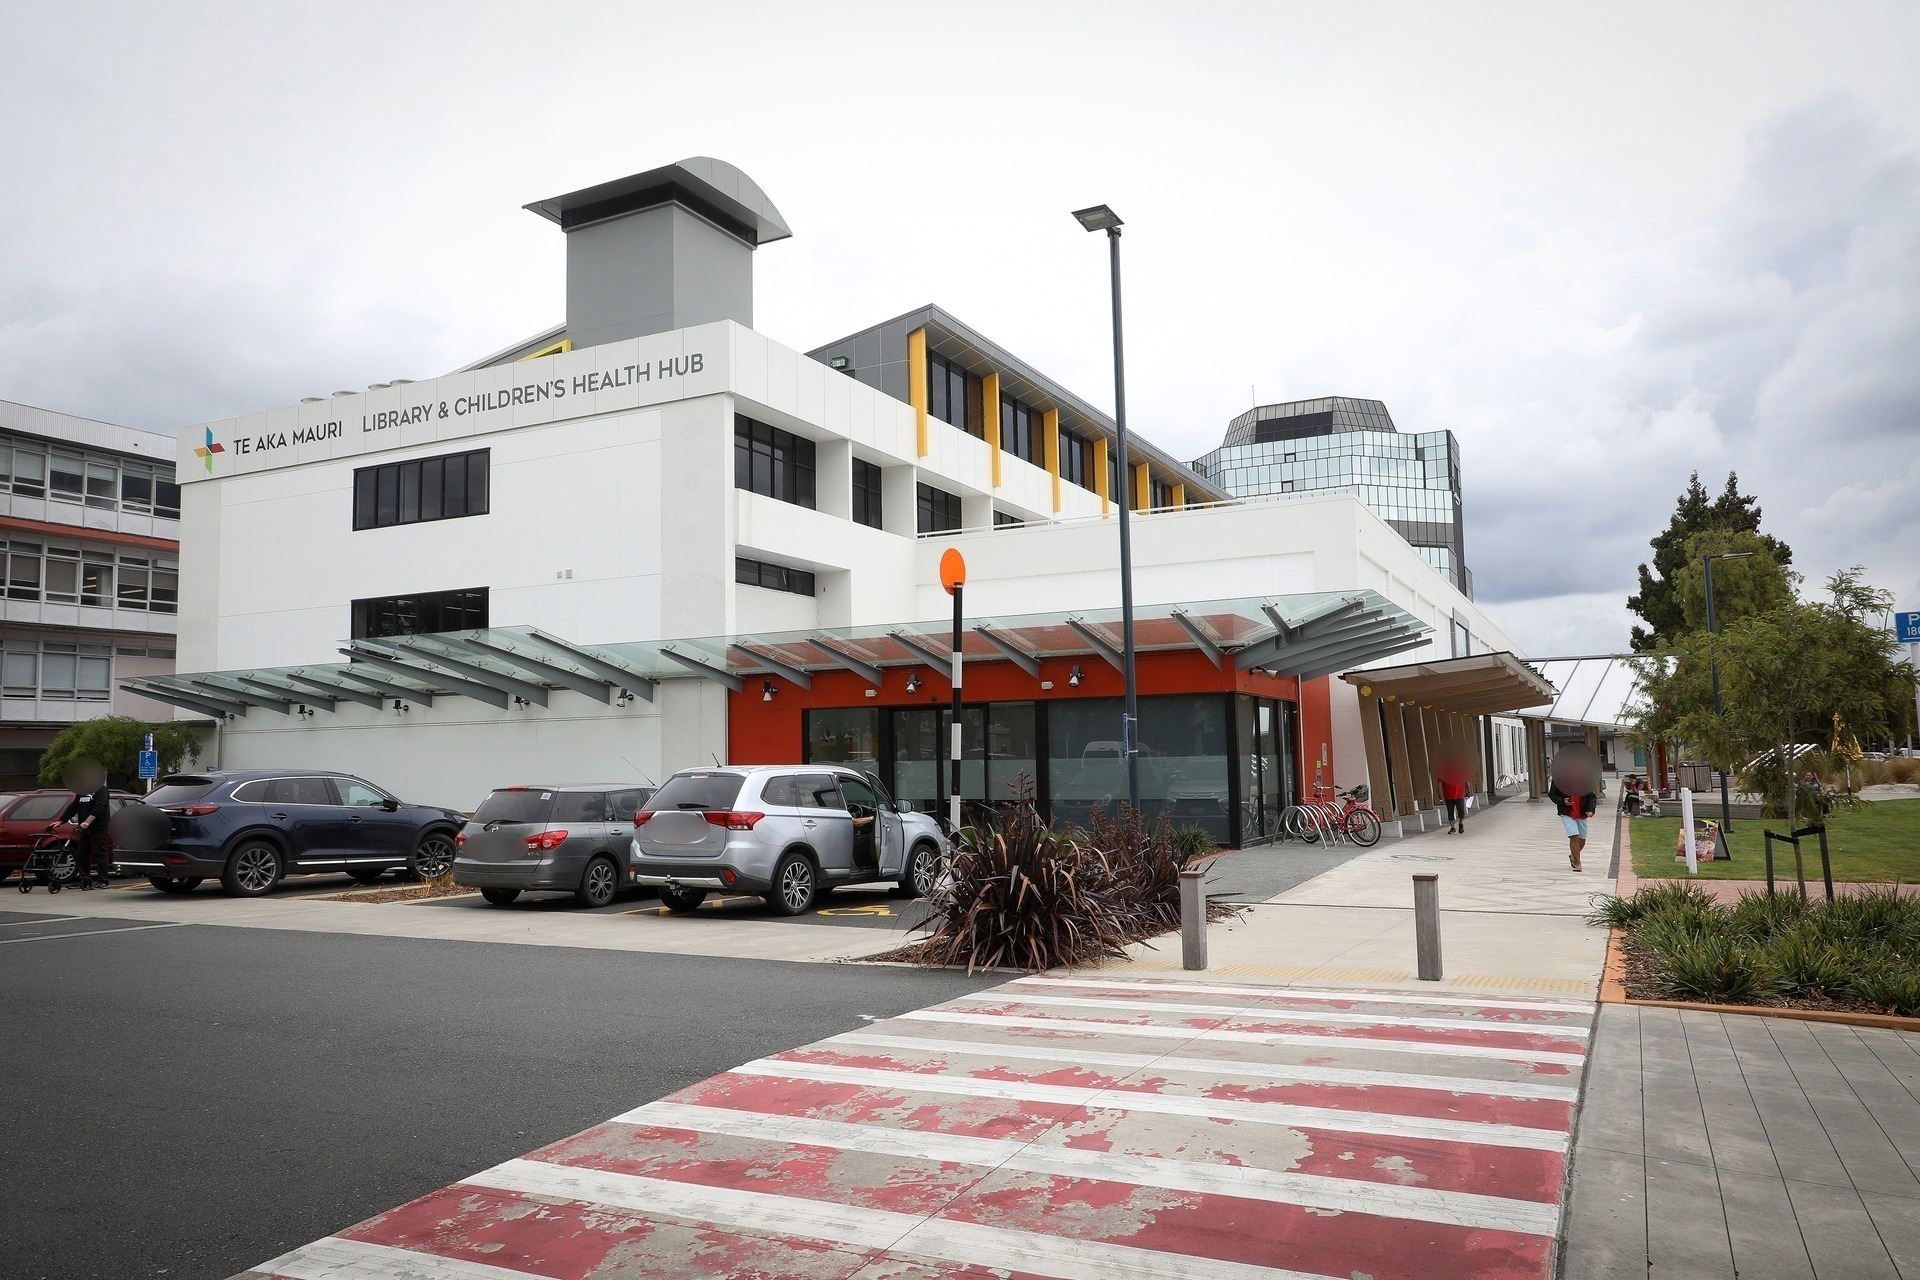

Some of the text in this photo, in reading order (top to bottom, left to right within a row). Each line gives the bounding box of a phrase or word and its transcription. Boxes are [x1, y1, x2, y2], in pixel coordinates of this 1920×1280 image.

[362, 353, 704, 433] LIBRARY & CHILDREN'S HEALTH HUB
[233, 420, 342, 456] TE AKA MAURI
[1908, 613, 1920, 626] P
